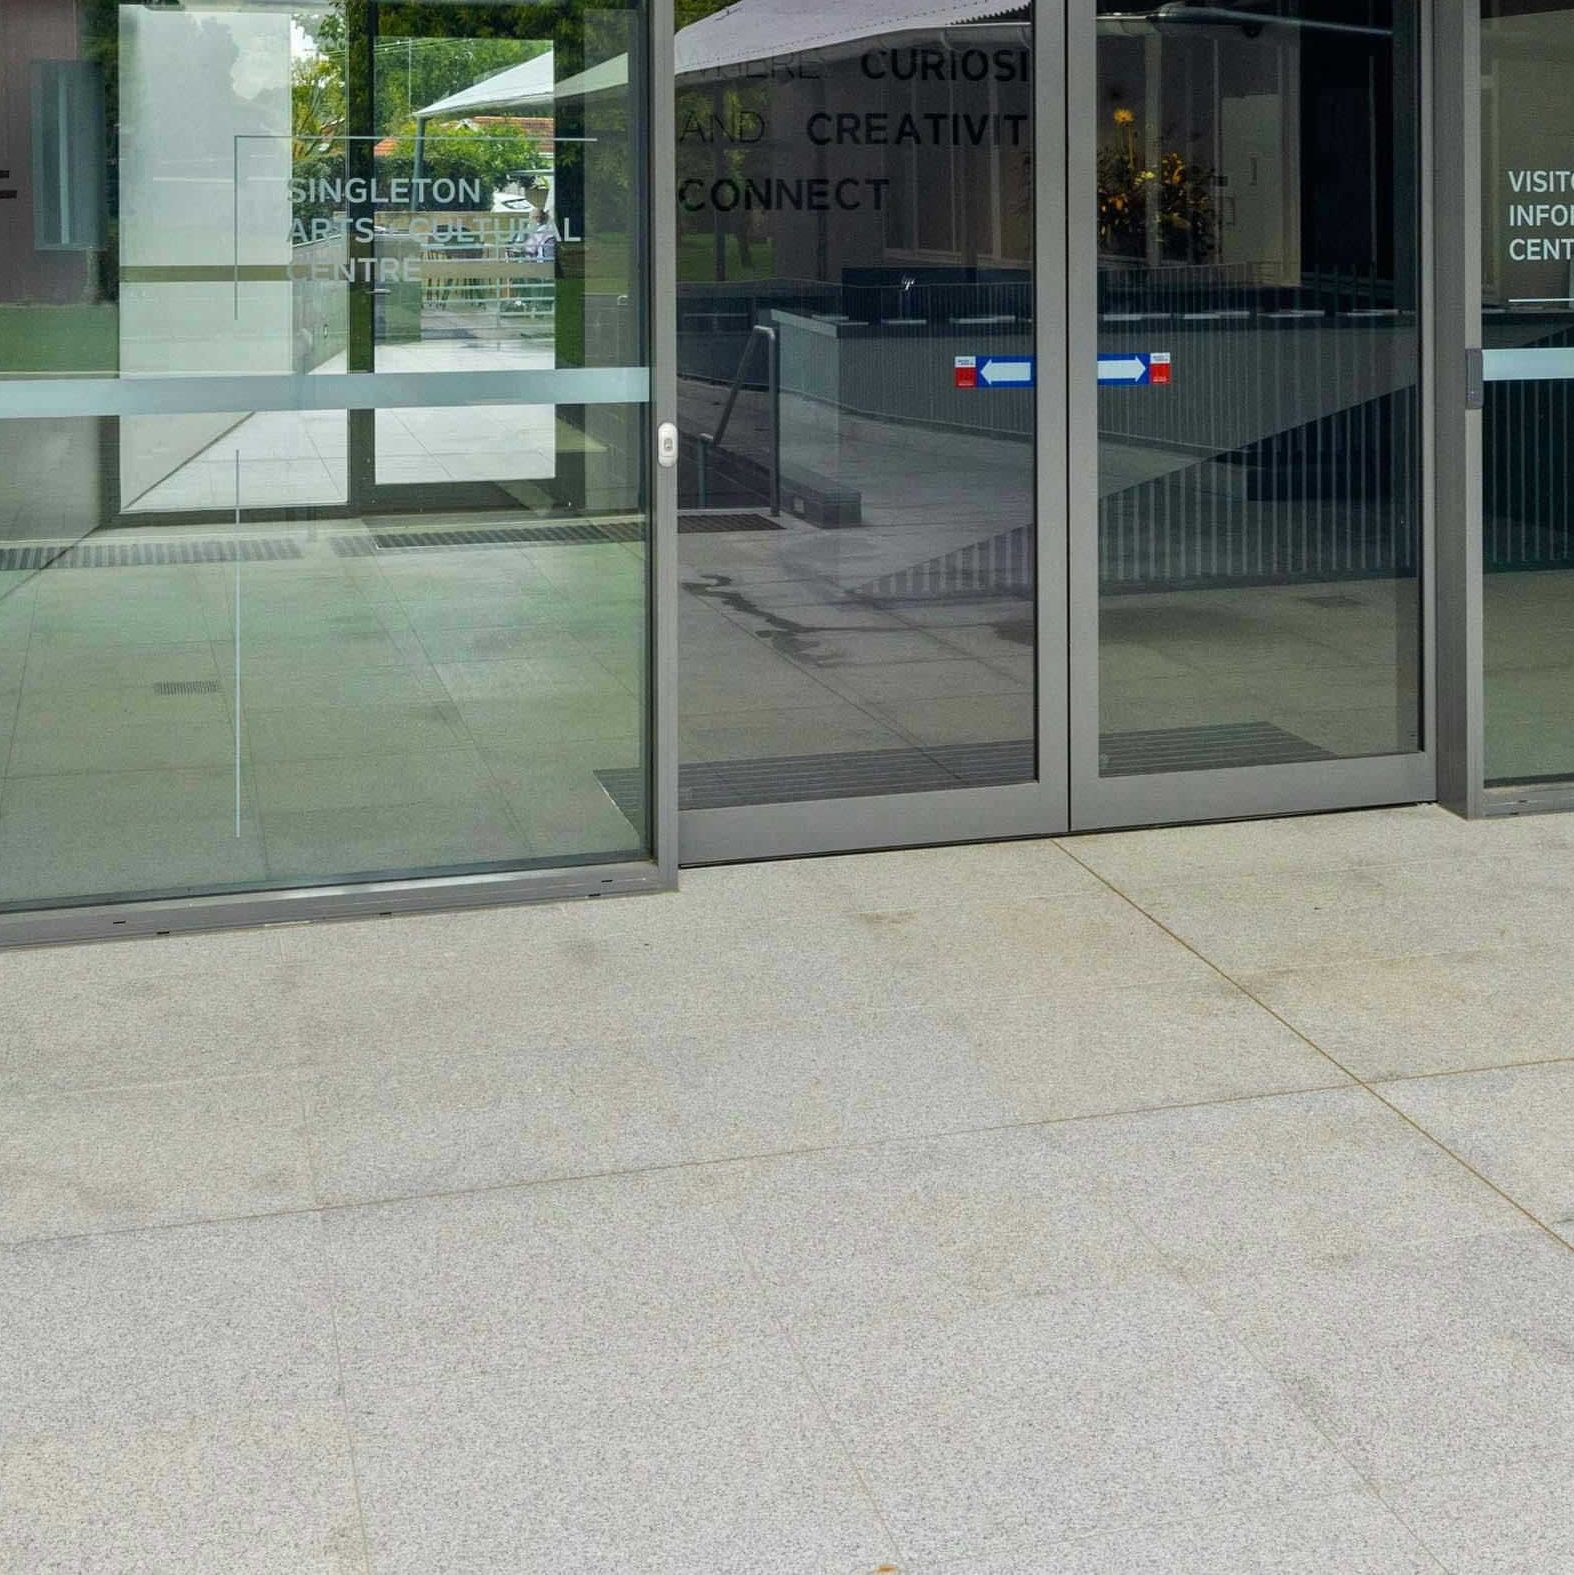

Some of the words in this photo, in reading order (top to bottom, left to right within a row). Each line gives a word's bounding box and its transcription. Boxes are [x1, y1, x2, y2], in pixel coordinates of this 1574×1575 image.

[679, 111, 766, 144] AND
[287, 177, 481, 204] SINGLETON
[678, 177, 890, 212] CONNECT
[287, 218, 374, 244] ARTS
[409, 217, 582, 244] CULTURAL
[287, 257, 422, 283] CENTRE
